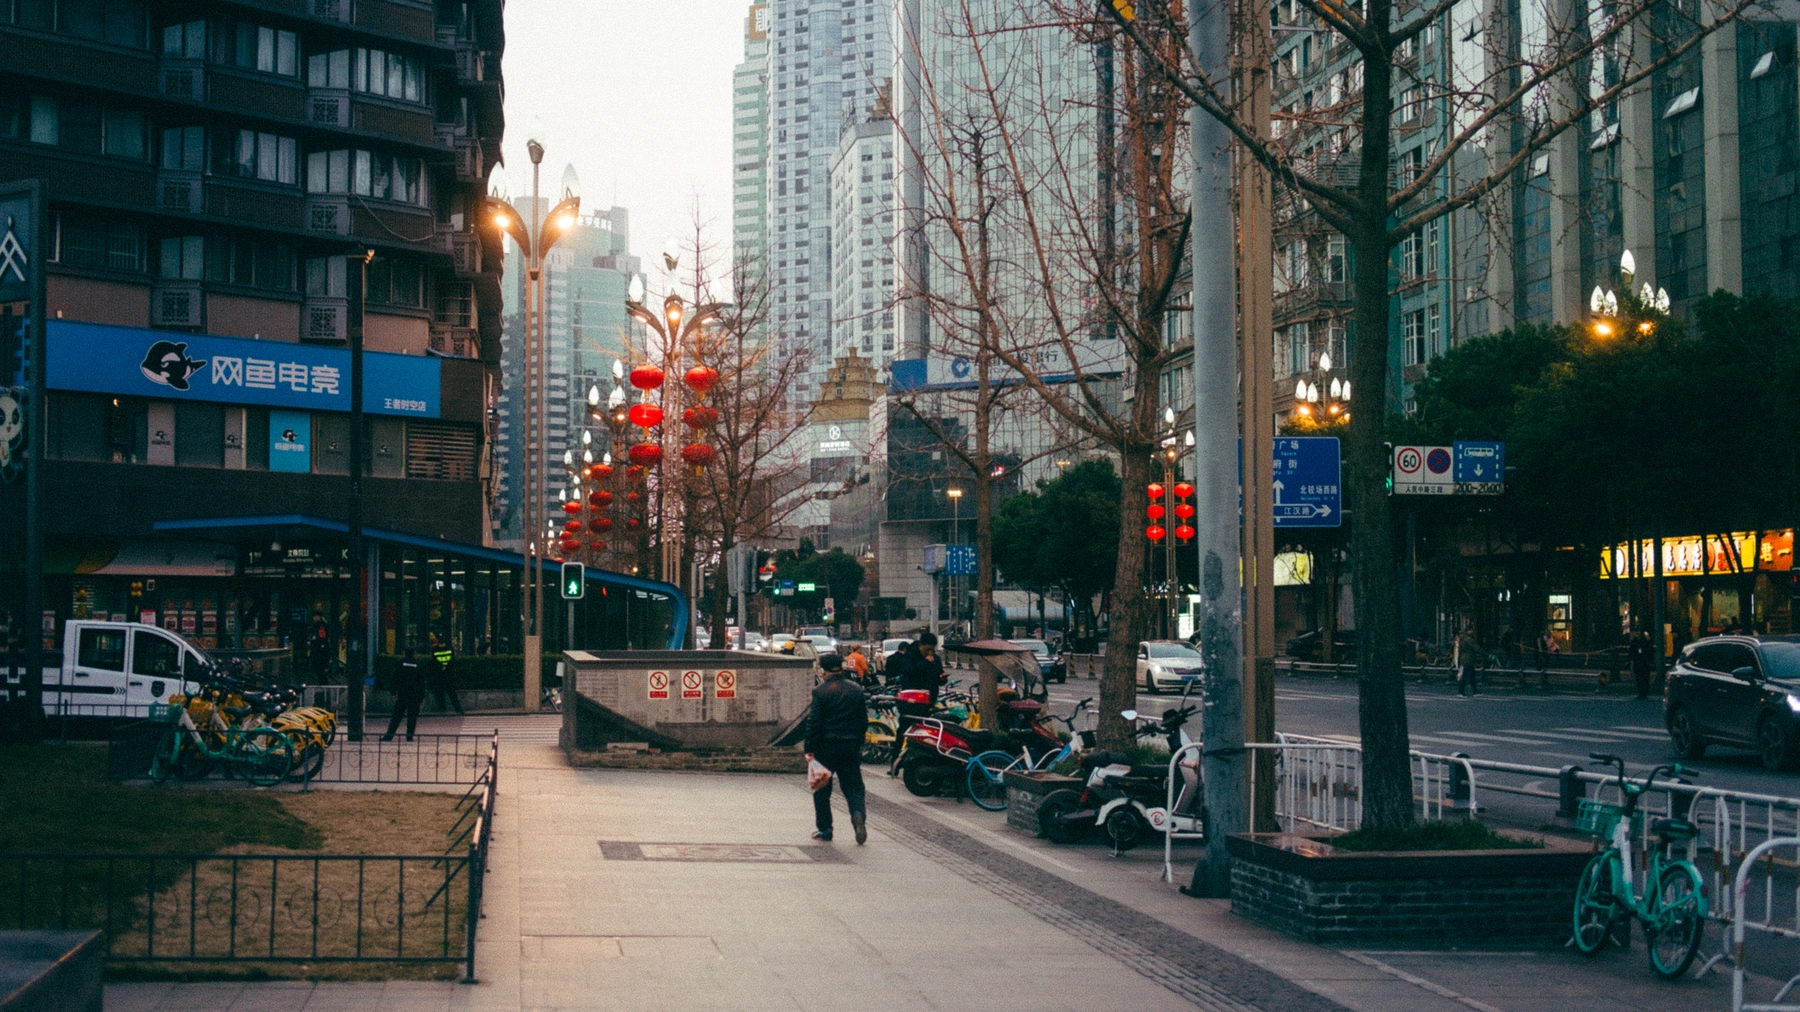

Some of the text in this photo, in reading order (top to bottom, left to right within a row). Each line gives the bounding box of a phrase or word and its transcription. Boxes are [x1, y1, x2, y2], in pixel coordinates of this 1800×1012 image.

[211, 355, 340, 395] 网鱼电竞
[383, 397, 427, 412] 王者时空店
[1274, 440, 1299, 450] 广场
[1402, 454, 1417, 468] 60
[1405, 485, 1443, 493] 人民中路三段
[1284, 507, 1310, 516] 江汉路
